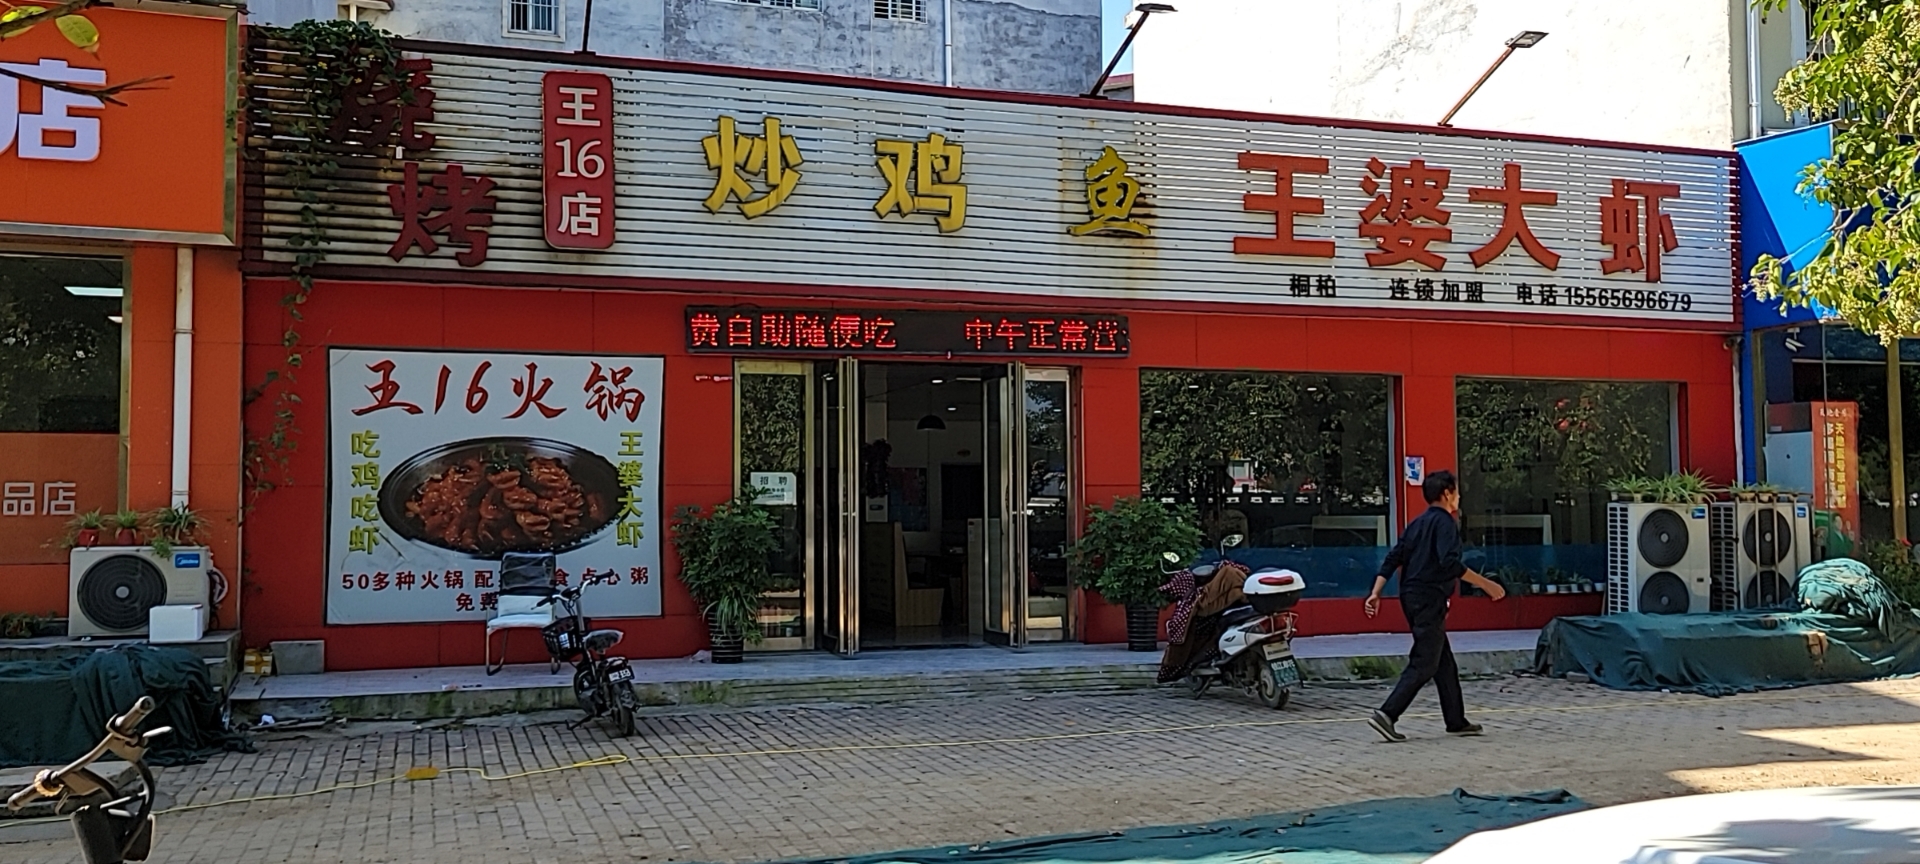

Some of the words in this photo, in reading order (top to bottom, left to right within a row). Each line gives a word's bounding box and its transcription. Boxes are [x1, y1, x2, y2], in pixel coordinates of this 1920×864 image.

[0, 58, 106, 161] 店
[556, 86, 605, 236] 王16店
[1233, 151, 1681, 282] 王婆大虾
[965, 317, 1127, 350] 中午正常营
[1290, 273, 1337, 297] 桐柏
[1390, 277, 1485, 303] 连锁加盟
[1516, 283, 1558, 306] 电话
[1565, 287, 1692, 311] 15565696679
[351, 360, 646, 423] 王16火锅
[3, 481, 76, 515] 品店
[348, 430, 381, 553] 吃鸡吃虾
[616, 431, 644, 548] 王婆大虾
[341, 570, 464, 591] 50多种火锅
[631, 566, 648, 585] 粥
